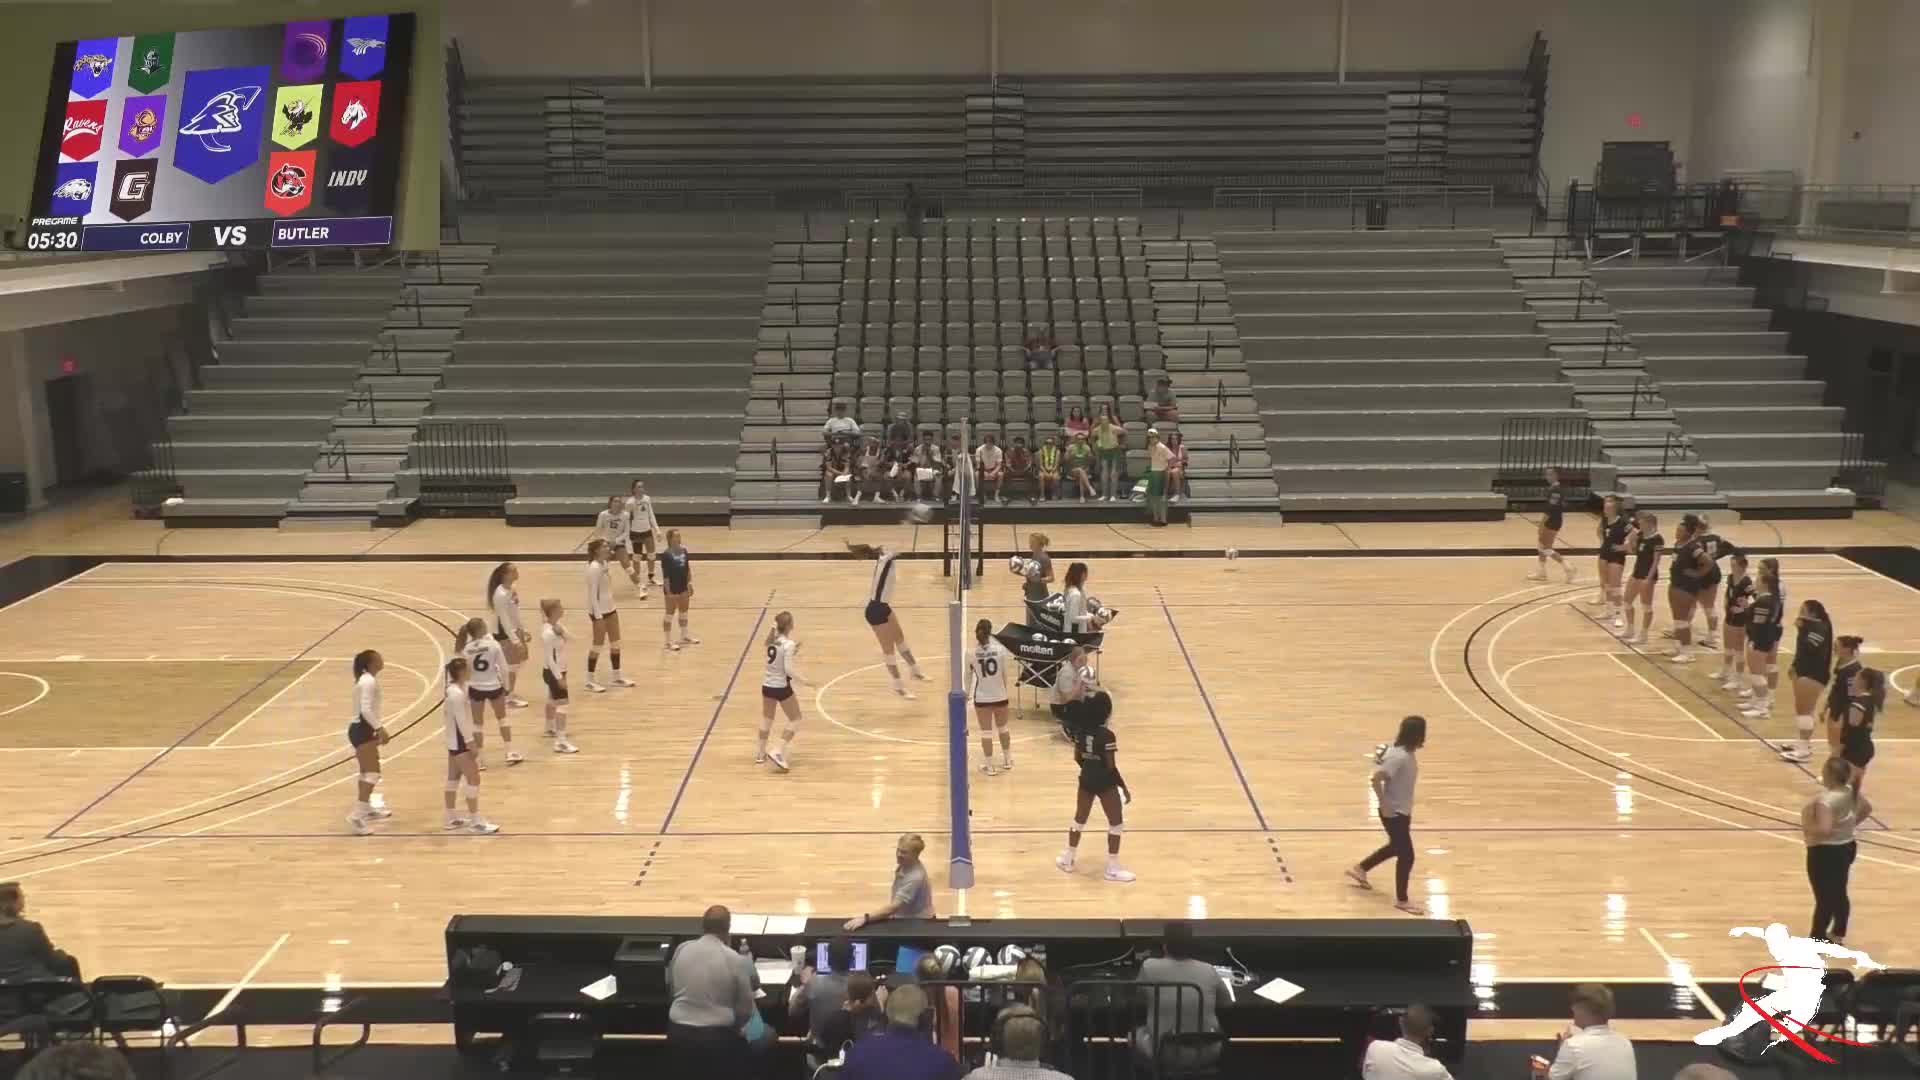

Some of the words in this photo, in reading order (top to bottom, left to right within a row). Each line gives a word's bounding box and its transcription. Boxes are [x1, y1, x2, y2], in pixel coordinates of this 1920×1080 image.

[63, 117, 104, 136] Ravens
[118, 171, 150, 201] G
[328, 169, 368, 187] INDY
[31, 217, 79, 226] PREGAME
[28, 232, 78, 249] 05:30
[140, 232, 183, 244] COLBY
[214, 226, 247, 246] VS
[278, 227, 329, 240] BUTLER
[767, 645, 777, 664] 9
[1020, 644, 1053, 656] molten
[473, 653, 489, 672] 6
[978, 657, 998, 678] 10
